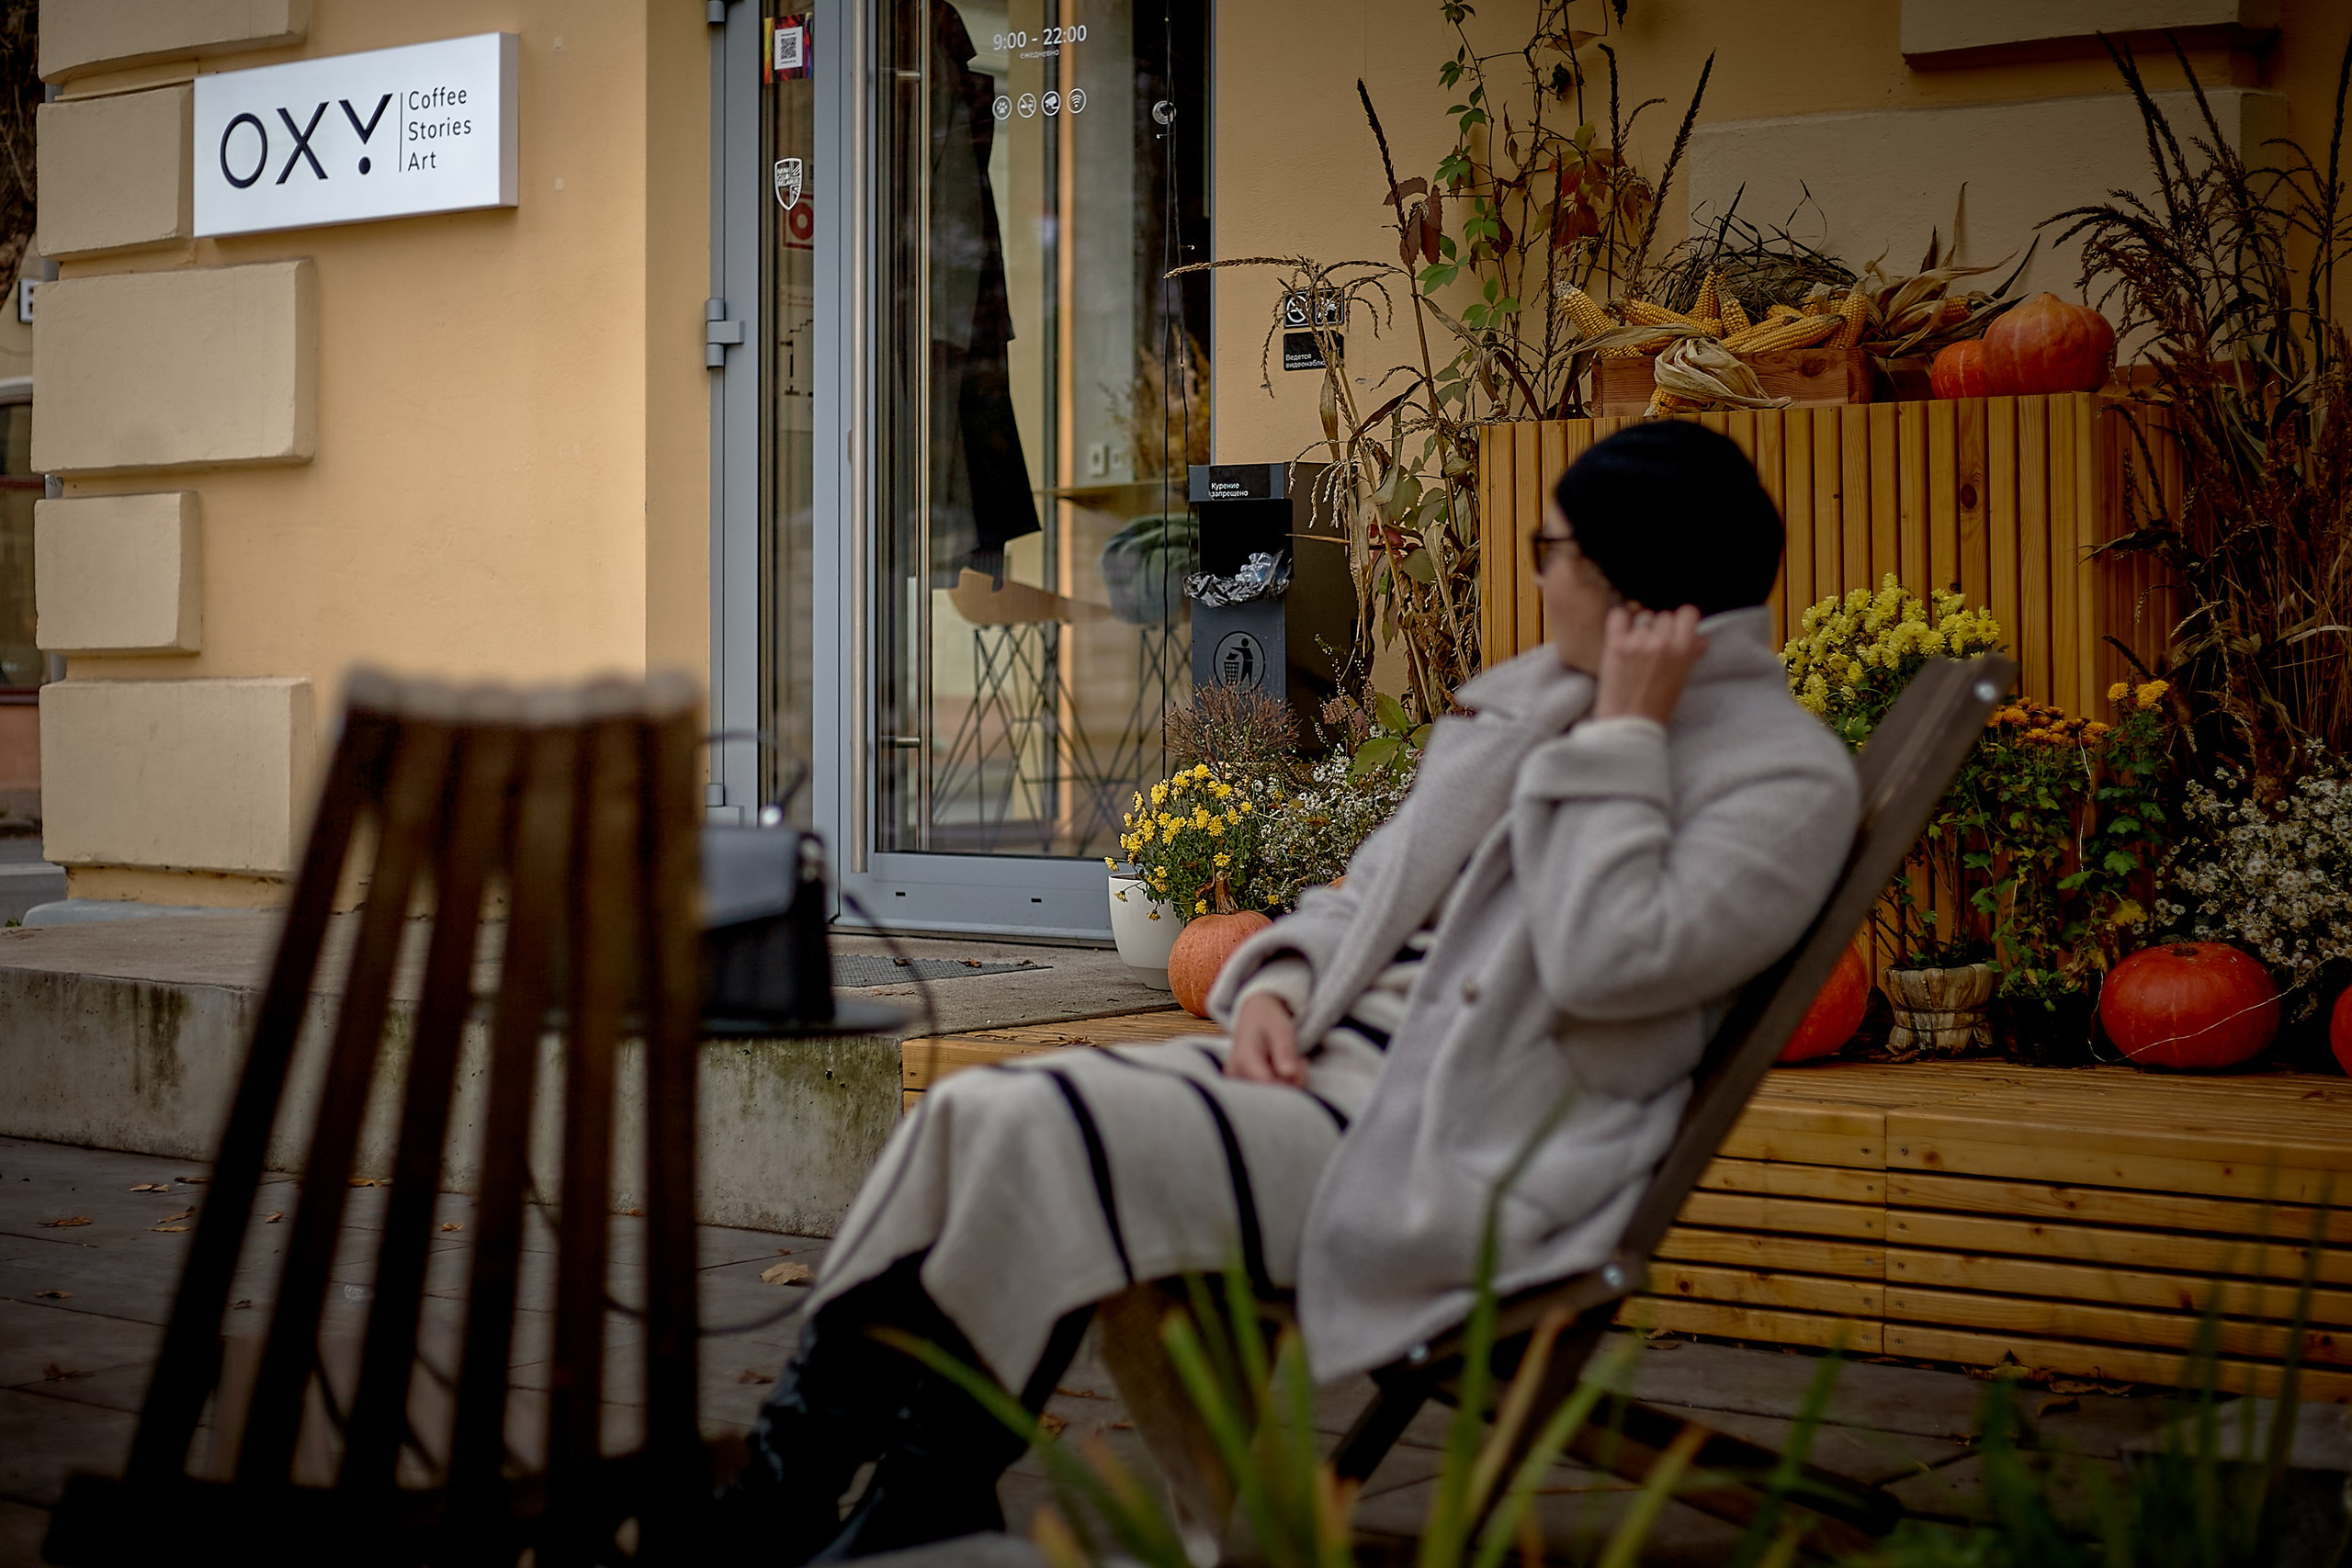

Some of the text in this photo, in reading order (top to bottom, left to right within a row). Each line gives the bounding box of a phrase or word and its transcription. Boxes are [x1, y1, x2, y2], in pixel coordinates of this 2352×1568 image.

[993, 30, 1027, 51] 9:00
[1043, 24, 1088, 45] 22:00
[1020, 49, 1060, 60] ежедневно
[408, 86, 468, 111] Coffee
[408, 117, 472, 141] Stories
[407, 151, 436, 172] Art
[1285, 353, 1312, 362] Ведется
[1211, 482, 1240, 491] Курение
[1211, 490, 1249, 499] запрещено
